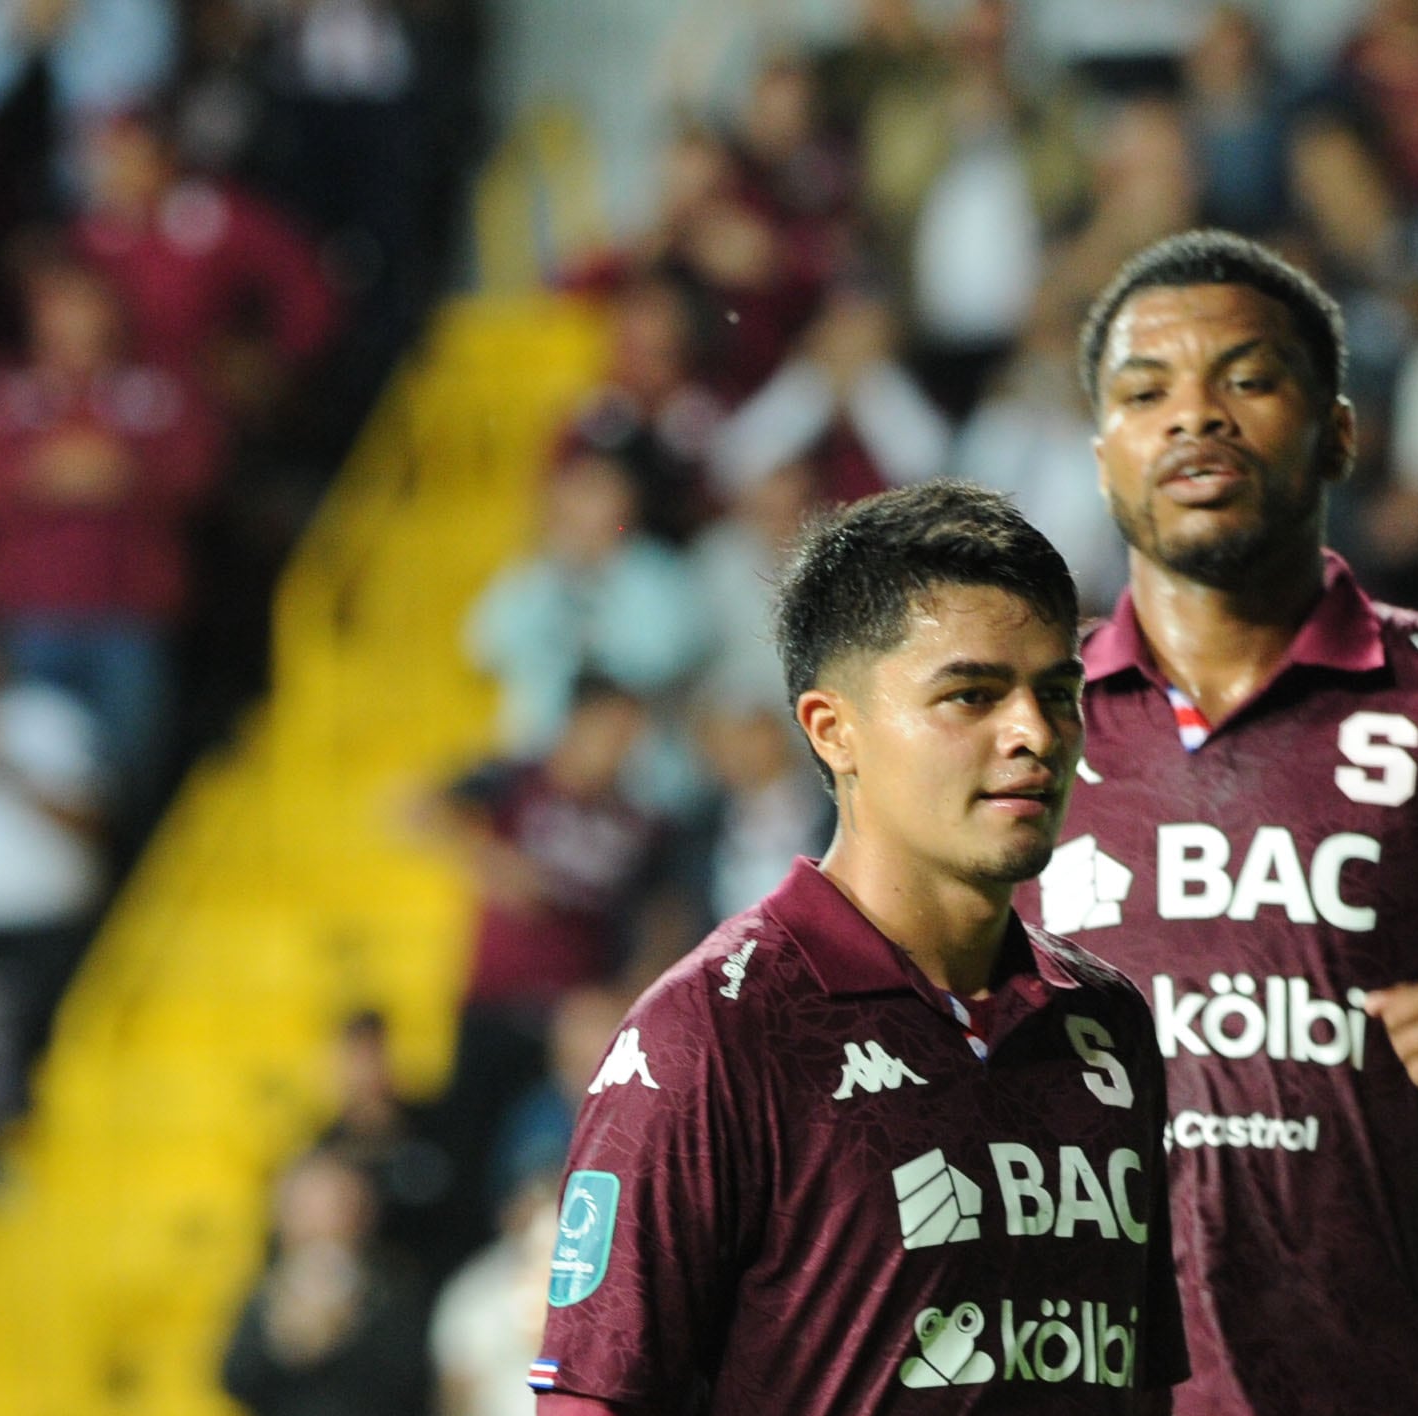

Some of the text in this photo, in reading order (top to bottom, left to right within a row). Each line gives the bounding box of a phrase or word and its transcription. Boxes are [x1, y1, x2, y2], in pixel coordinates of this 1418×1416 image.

[1156, 822, 1382, 932] BAC
[1065, 1014, 1135, 1109] S
[1152, 972, 1367, 1072] kölbi
[1173, 1110, 1319, 1152] Castrol
[988, 1142, 1148, 1244] BAC
[1000, 1298, 1139, 1388] kölbi
